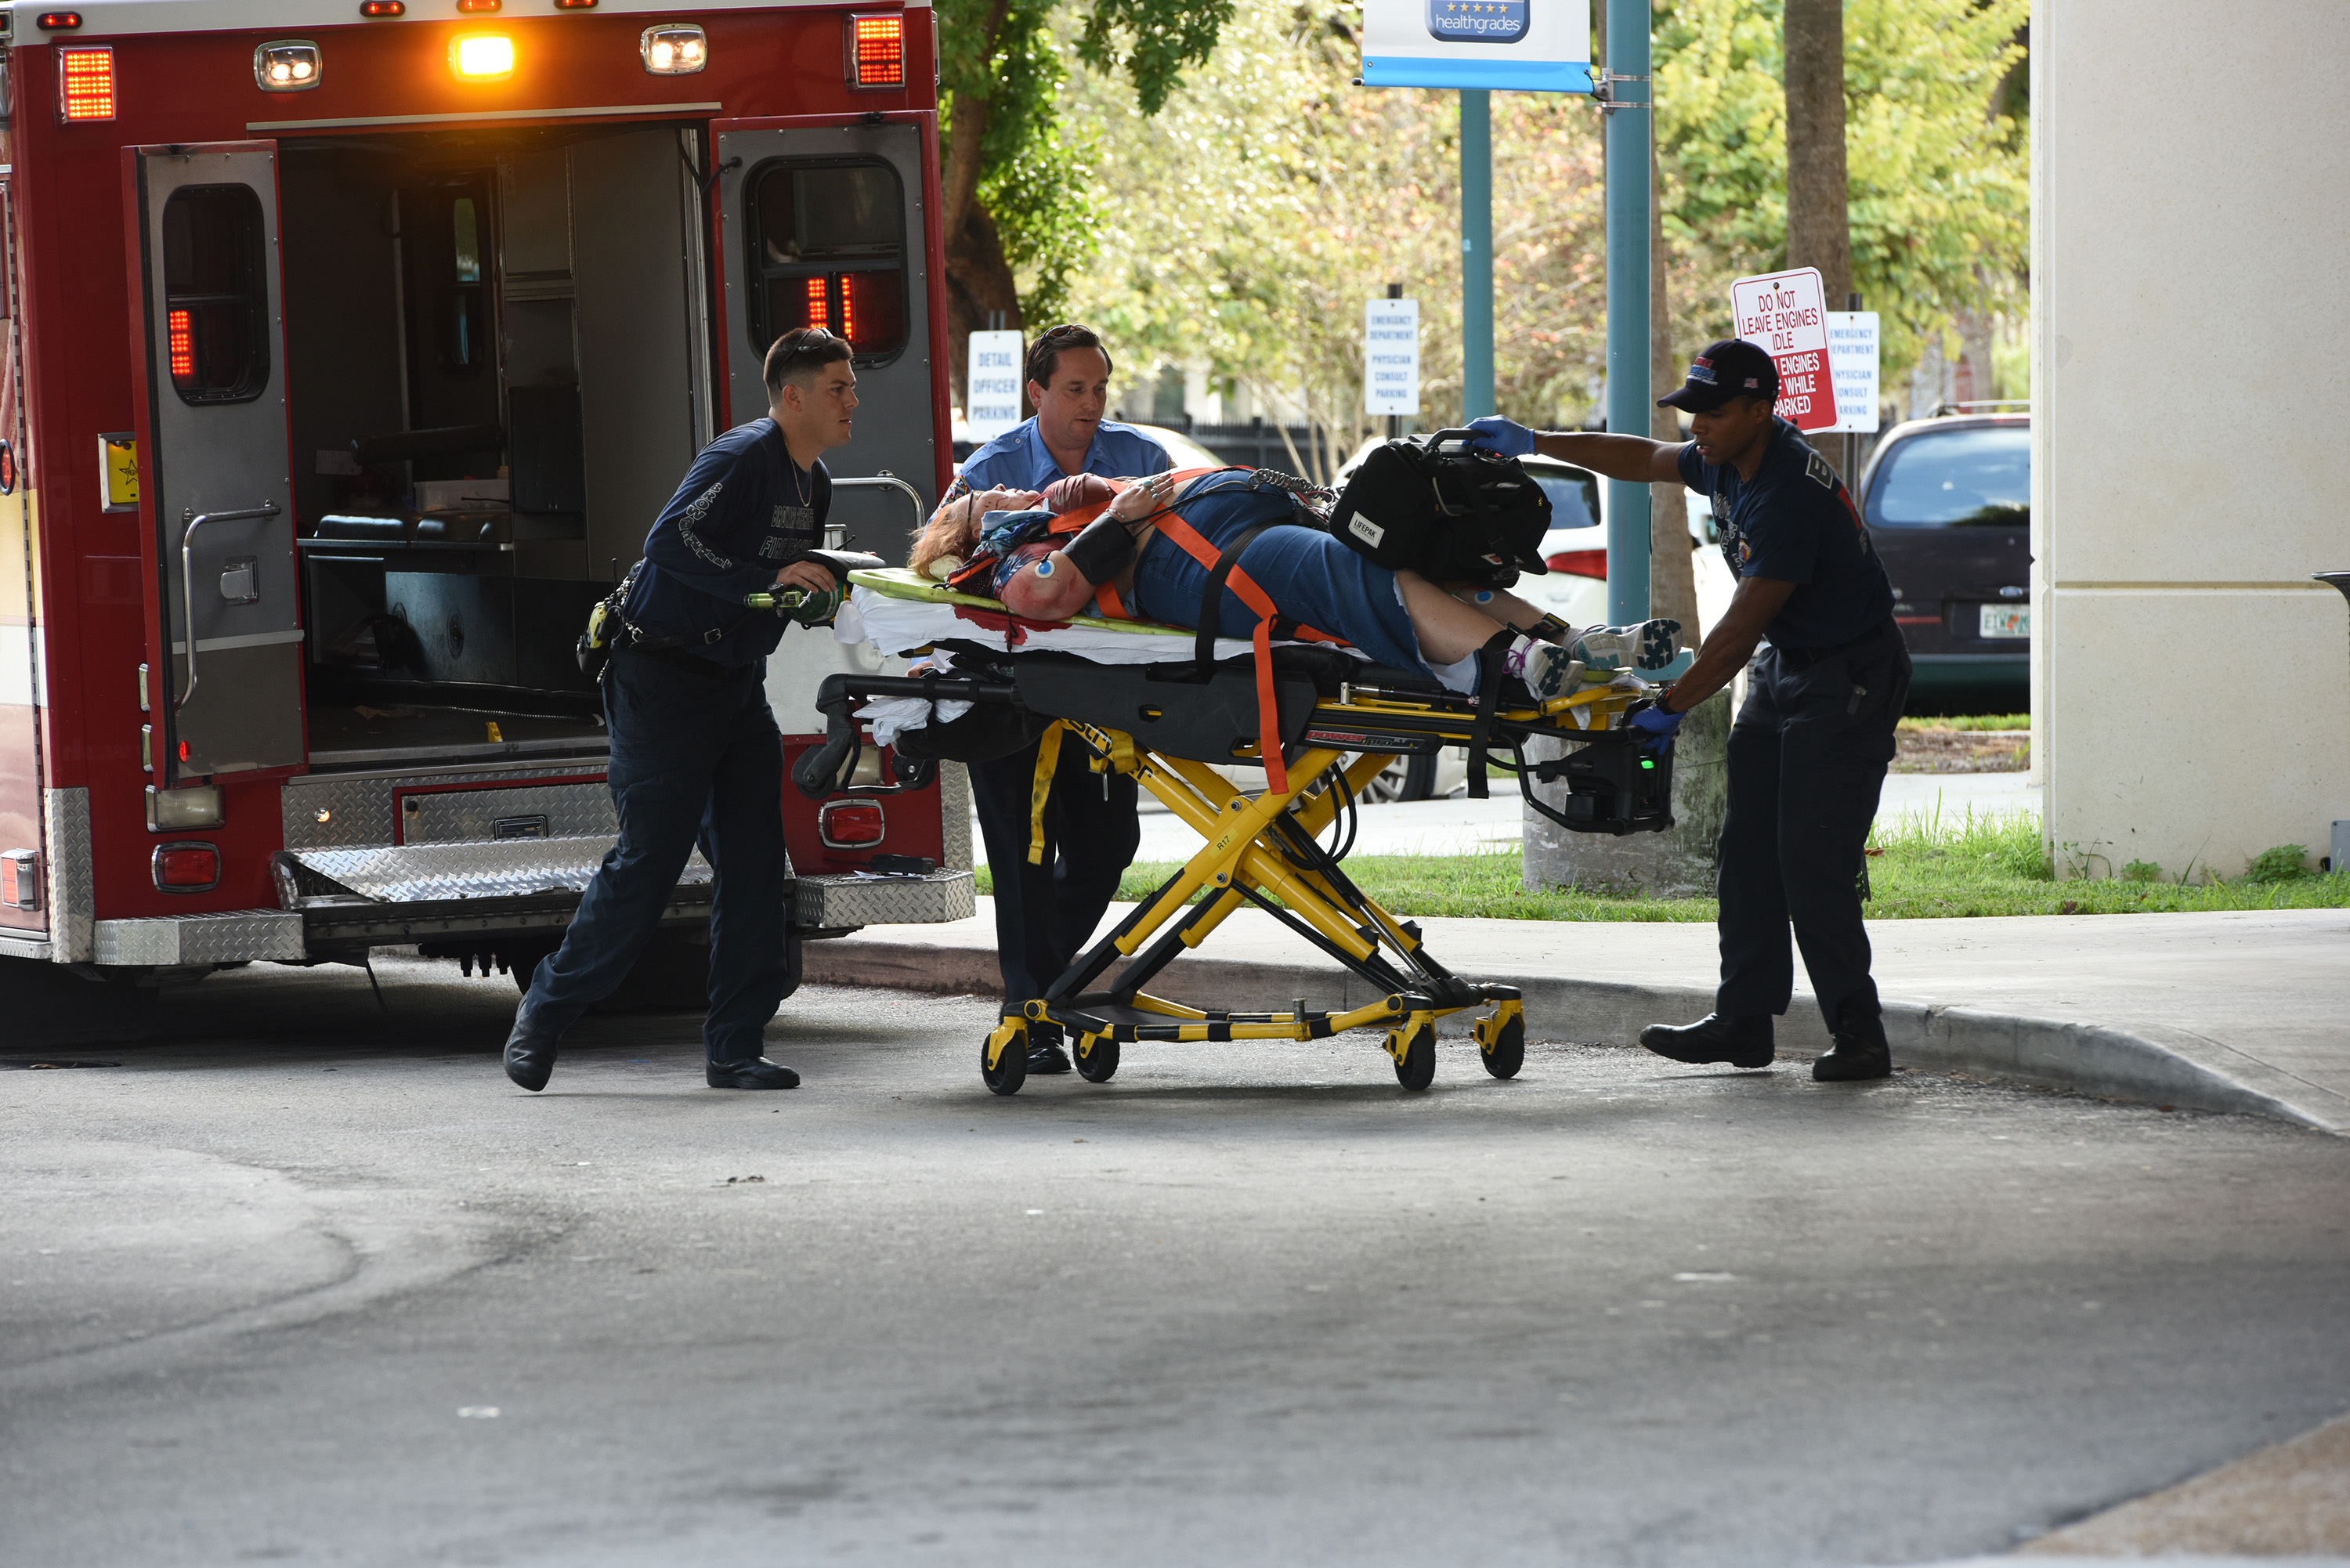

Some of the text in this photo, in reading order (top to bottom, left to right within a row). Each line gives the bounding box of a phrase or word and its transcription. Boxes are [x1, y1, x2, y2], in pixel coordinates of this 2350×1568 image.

[1436, 14, 1520, 34] healthgrades
[1758, 291, 1795, 313] DO NOT
[1372, 315, 1412, 325] EMERGENCY
[1741, 307, 1819, 335] LEAVE ENGINES
[1370, 330, 1413, 340] DEPARTMENT
[1830, 328, 1873, 338] EMERGENCY
[1772, 331, 1795, 351] IDLE
[1831, 345, 1874, 355] EPARTMENT
[978, 352, 1011, 367] DETAIL
[1372, 355, 1412, 364] PHYSICIAN
[1780, 352, 1820, 376] ENGINES
[1375, 371, 1408, 381] CONSULT
[1835, 370, 1872, 380] HYSICIAN
[974, 379, 1016, 393] OFFICER
[1784, 374, 1817, 396] WHILE
[1376, 388, 1407, 398] PARKING
[1838, 388, 1867, 398] ONSULT
[972, 406, 1016, 420] PARKING
[1839, 406, 1867, 415] ARKING
[1354, 519, 1377, 538] LIFEPAK
[1305, 730, 1366, 742] power
[1365, 738, 1394, 746] pro
[1068, 719, 1153, 780] stryr
[1217, 835, 1230, 851] R17
